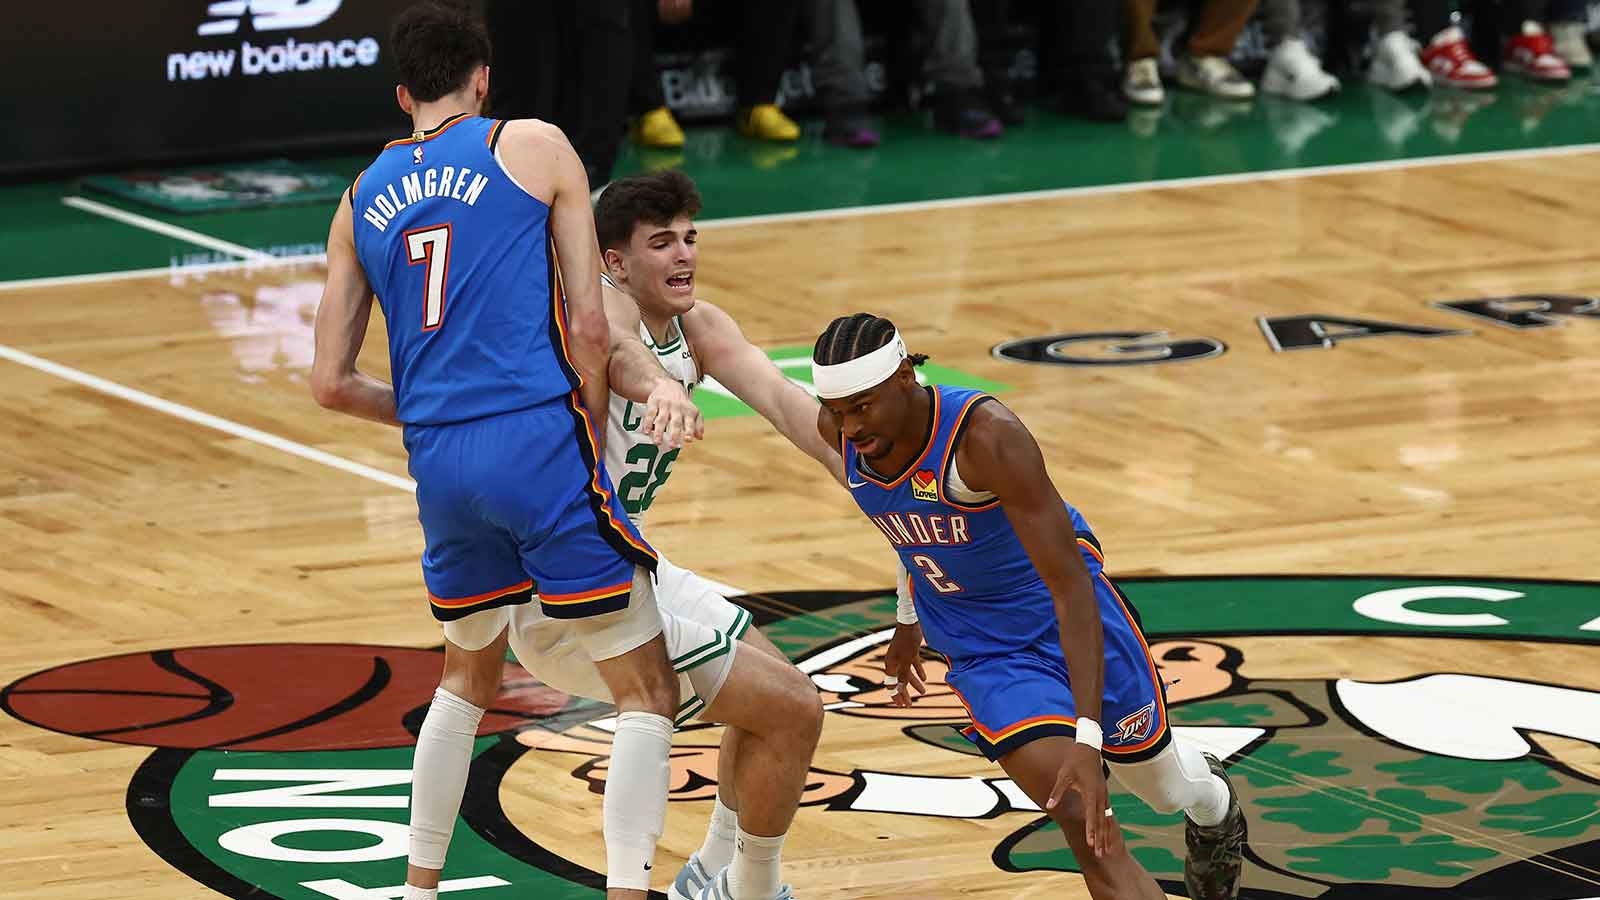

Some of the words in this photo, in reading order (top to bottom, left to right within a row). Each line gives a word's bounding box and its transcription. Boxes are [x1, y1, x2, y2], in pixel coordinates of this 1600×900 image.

[166, 50, 236, 81] new
[240, 37, 380, 76] balance
[363, 166, 489, 232] HOLMGREN
[403, 223, 452, 332] 7
[914, 488, 938, 500] Love's
[912, 553, 966, 595] 2
